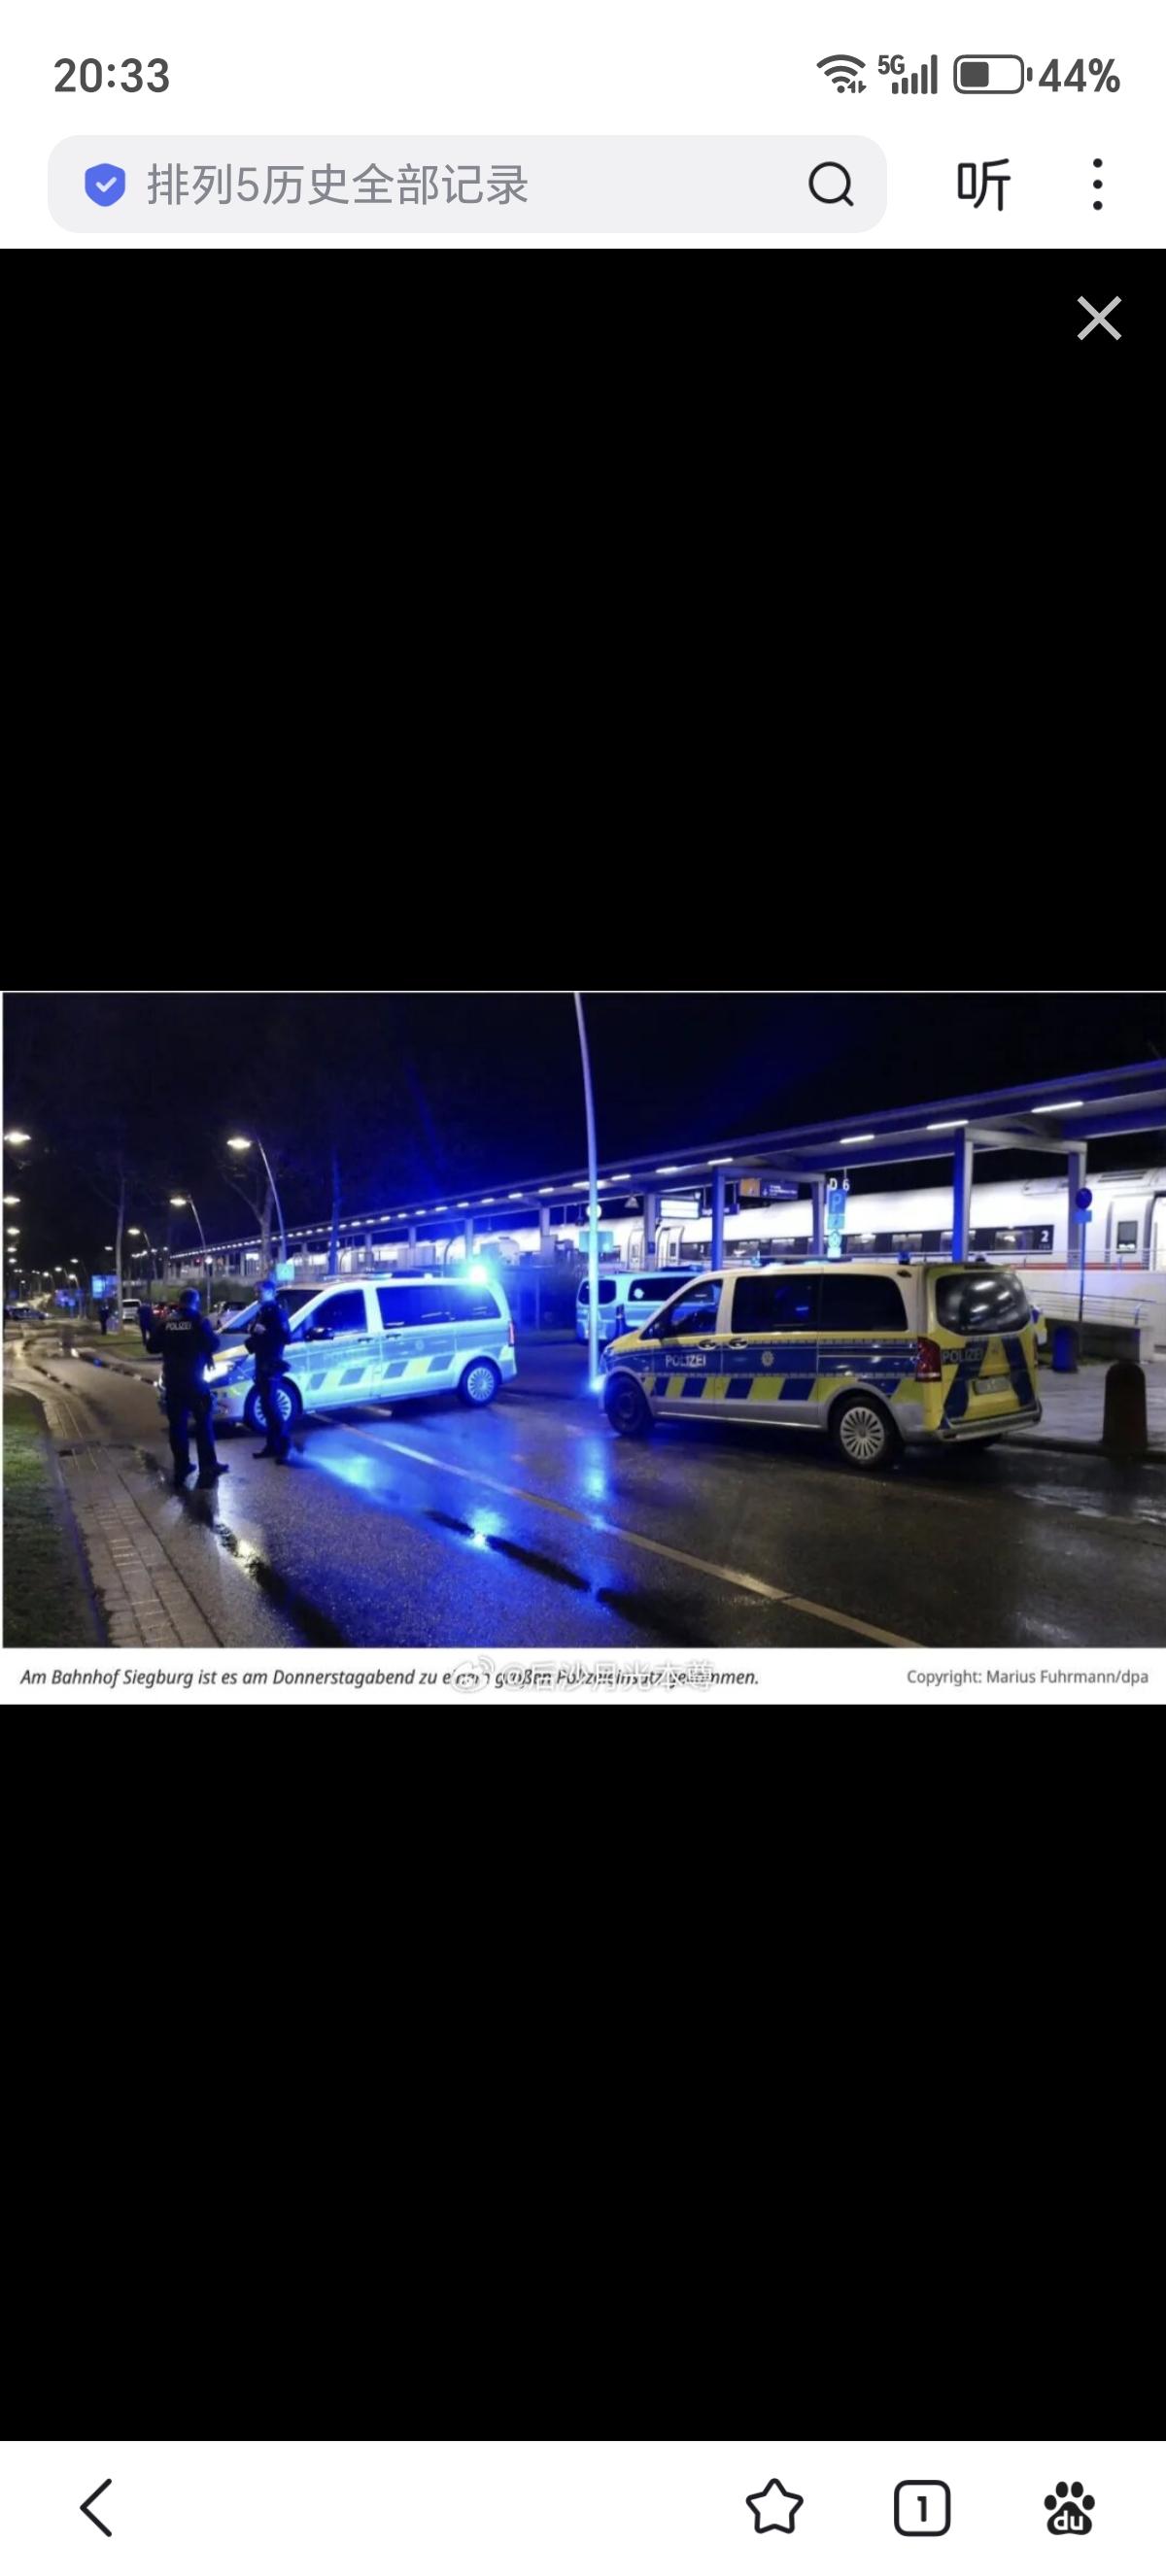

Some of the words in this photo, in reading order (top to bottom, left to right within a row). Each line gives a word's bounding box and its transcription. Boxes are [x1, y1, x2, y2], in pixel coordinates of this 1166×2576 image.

[53, 57, 170, 93] 20:33
[877, 53, 906, 75] 5G
[1038, 58, 1120, 93] 44%
[146, 162, 530, 206] 排列5历史全部记录
[956, 157, 1012, 212] 听
[1041, 1230, 1049, 1243] 2
[165, 1321, 192, 1331] POLIZEI
[665, 1354, 706, 1368] POLIZEI
[916, 2495, 927, 2523] 1
[1053, 2510, 1083, 2530] du
